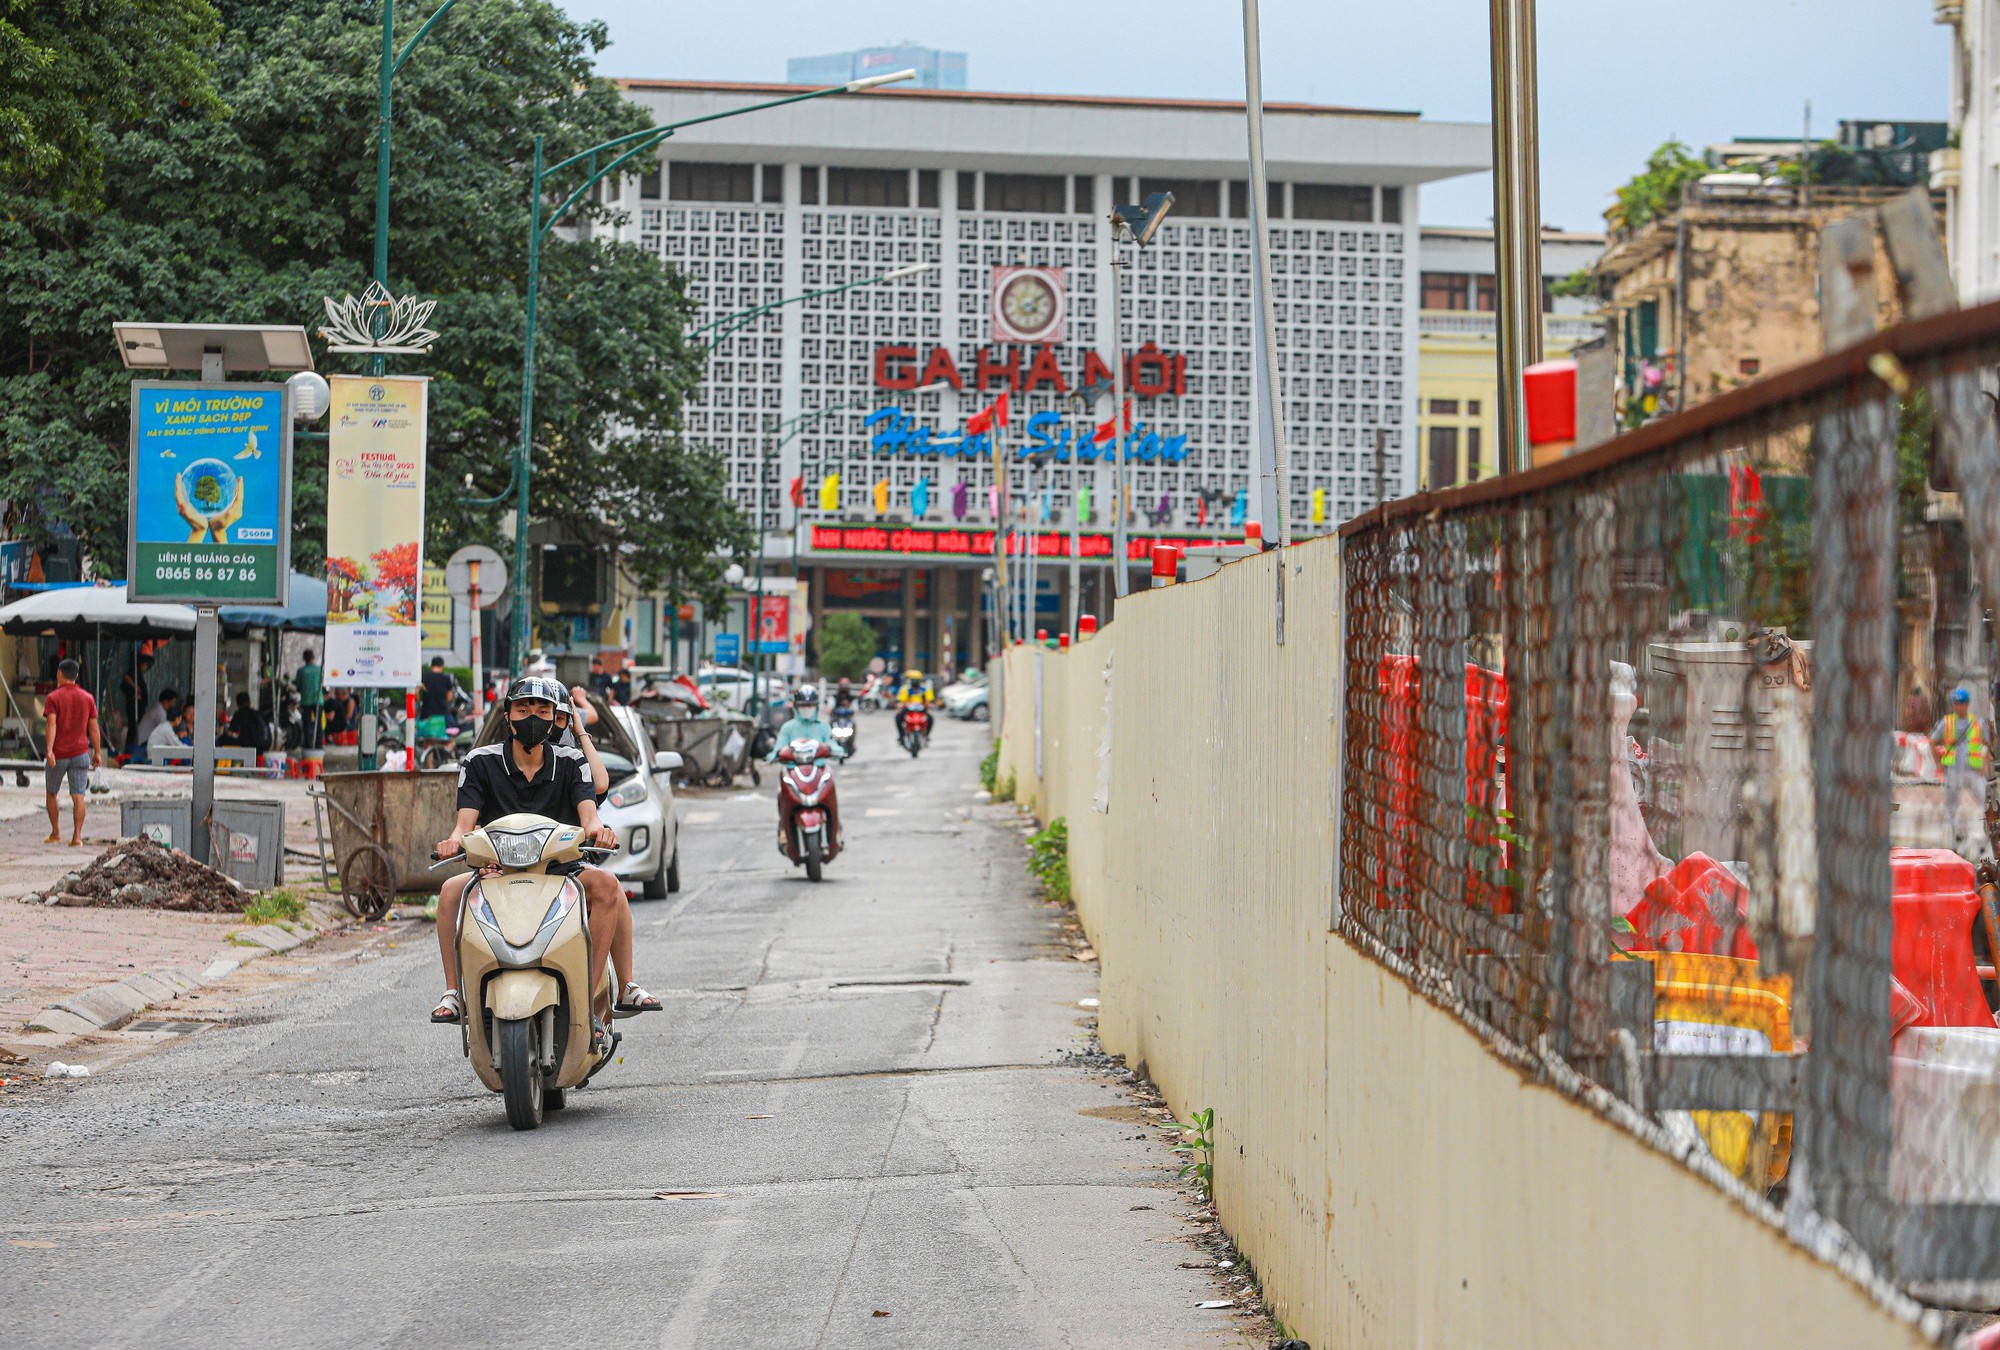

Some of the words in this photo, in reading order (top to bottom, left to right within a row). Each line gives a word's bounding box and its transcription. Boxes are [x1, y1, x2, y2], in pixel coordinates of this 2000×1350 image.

[874, 345, 963, 390] GA
[976, 340, 1068, 392] HÀ
[155, 398, 170, 414] VÌ
[172, 397, 202, 413] MÔI
[206, 395, 264, 411] TRƯỜNG
[165, 414, 197, 425] XANH
[199, 413, 230, 425] SẠCH
[232, 412, 252, 423] ĐẸP
[233, 425, 248, 433] QUY
[158, 552, 178, 563] LIÊN
[180, 552, 192, 565] HỆ
[194, 552, 231, 564] QUẢNG
[233, 553, 255, 564] CÁO
[156, 567, 191, 580] 0865
[195, 567, 213, 580] 86
[217, 568, 235, 581] 87
[239, 568, 257, 581] 86
